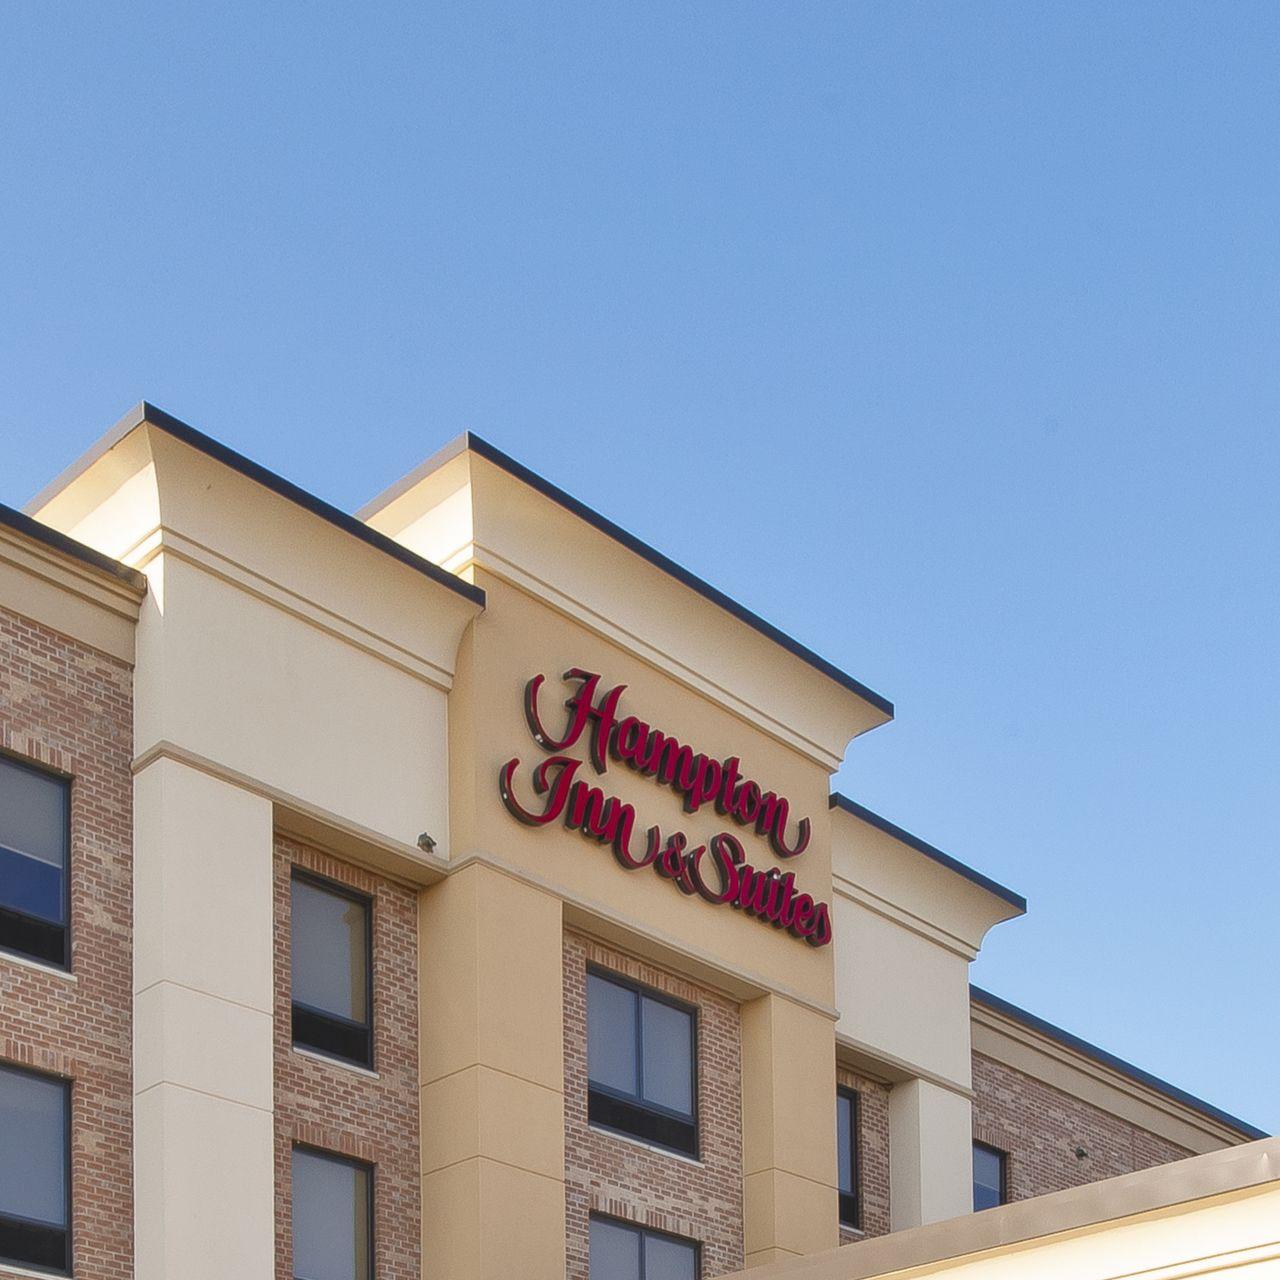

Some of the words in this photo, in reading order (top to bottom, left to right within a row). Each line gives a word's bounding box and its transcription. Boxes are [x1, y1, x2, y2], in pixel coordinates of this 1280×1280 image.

[499, 756, 660, 870] Inn
[653, 831, 696, 896] &
[686, 832, 832, 948] Suites
[524, 667, 811, 858] Hampton
